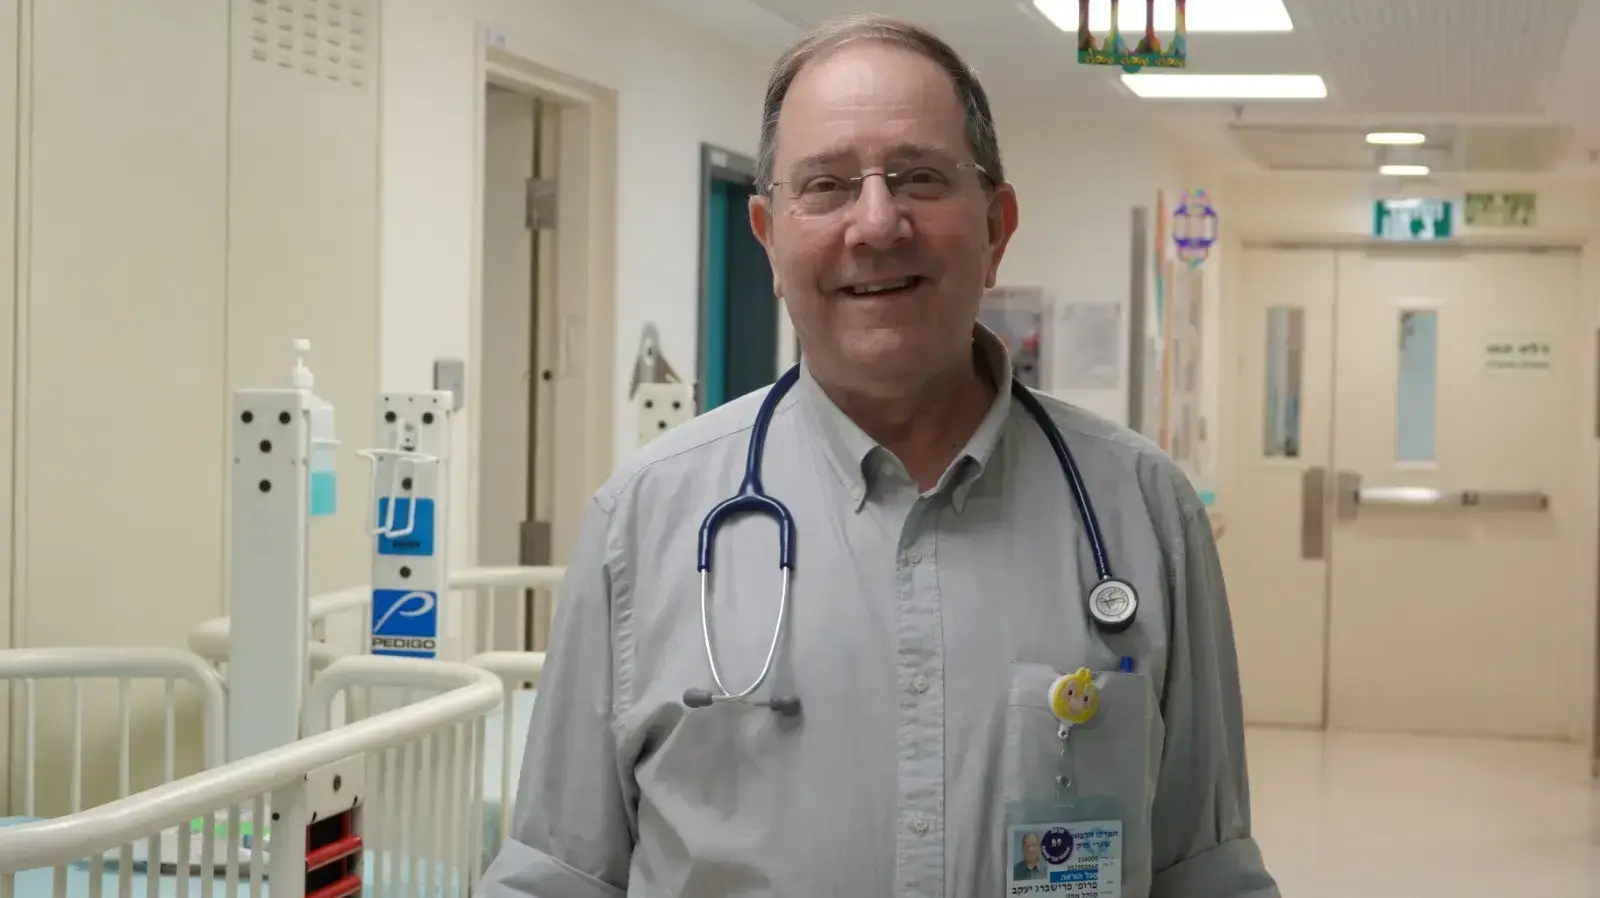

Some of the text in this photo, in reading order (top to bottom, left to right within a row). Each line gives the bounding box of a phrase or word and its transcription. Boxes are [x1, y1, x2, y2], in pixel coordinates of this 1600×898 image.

[372, 638, 436, 649] PEDIGO
[1012, 885, 1033, 896] יעקב
[1035, 883, 1073, 893] פרישברג
